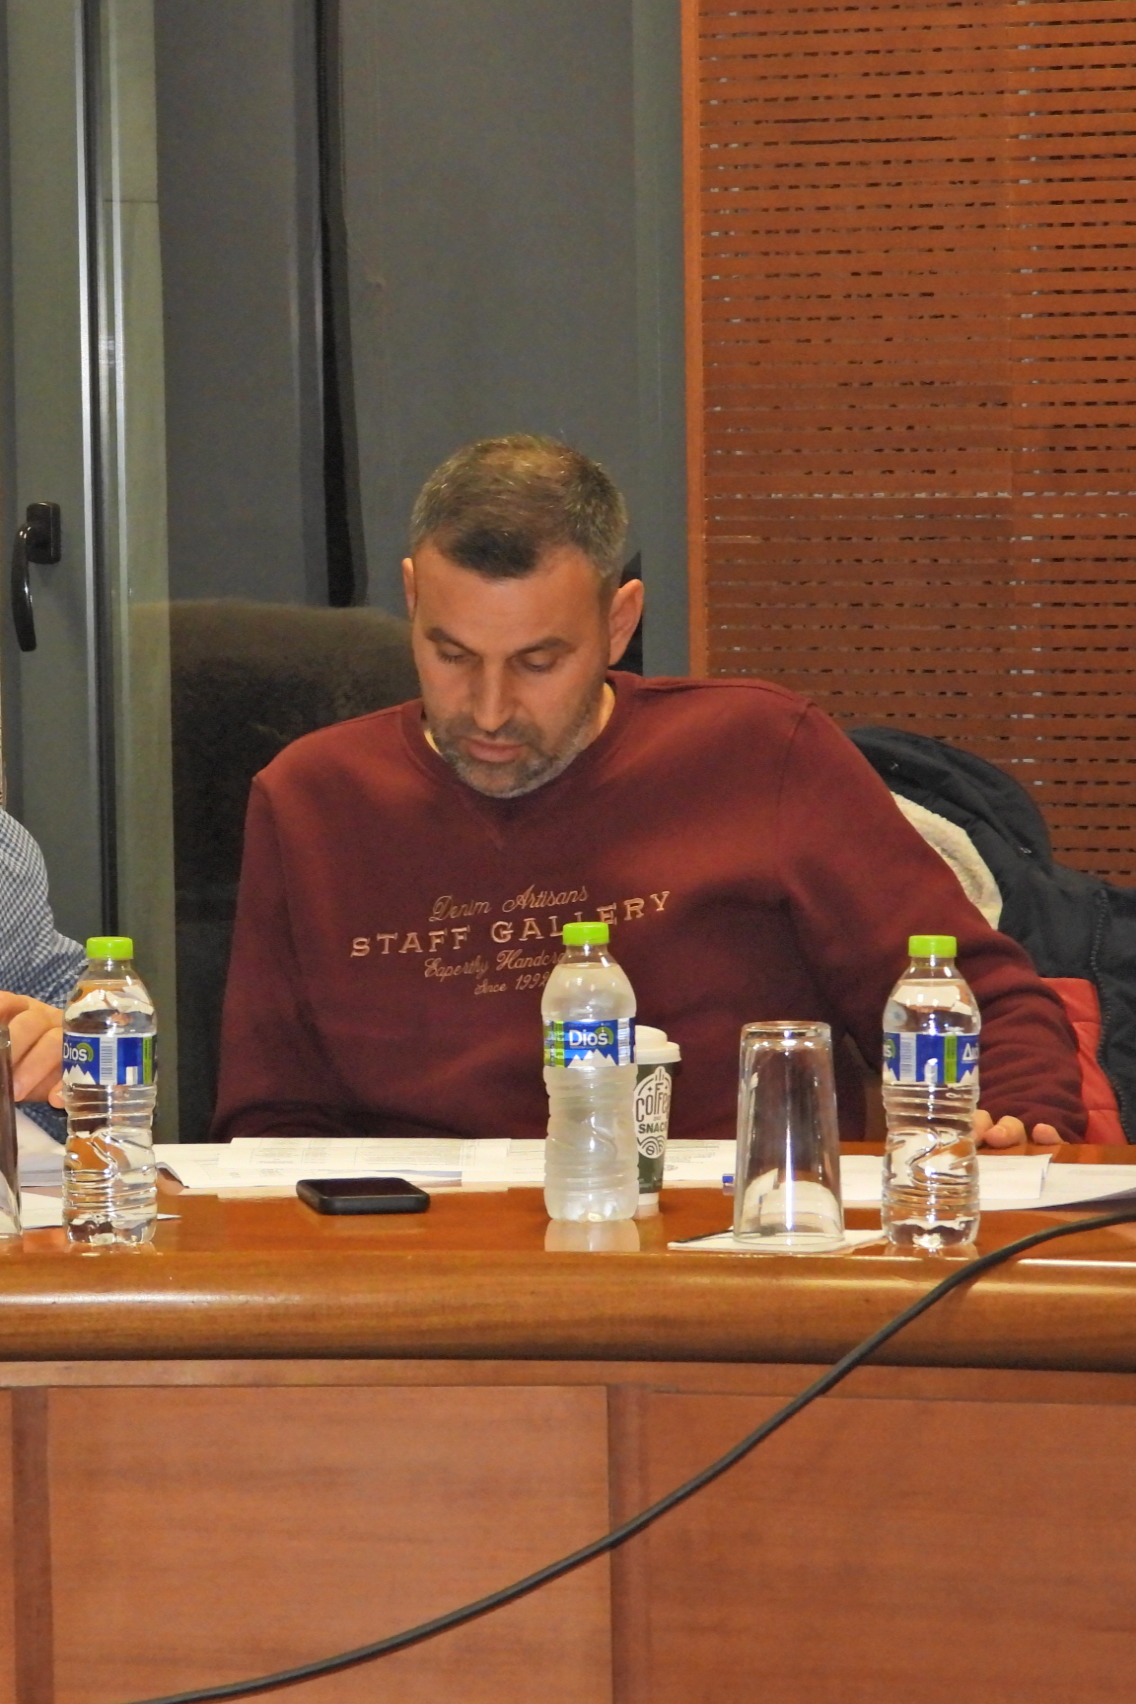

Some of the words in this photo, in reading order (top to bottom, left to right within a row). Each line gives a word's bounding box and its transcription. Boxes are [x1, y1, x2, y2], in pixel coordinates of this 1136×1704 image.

[429, 895, 491, 922] Denim
[502, 884, 590, 912] Artisans
[350, 925, 471, 958] STAFF
[569, 1029, 609, 1047] Dios
